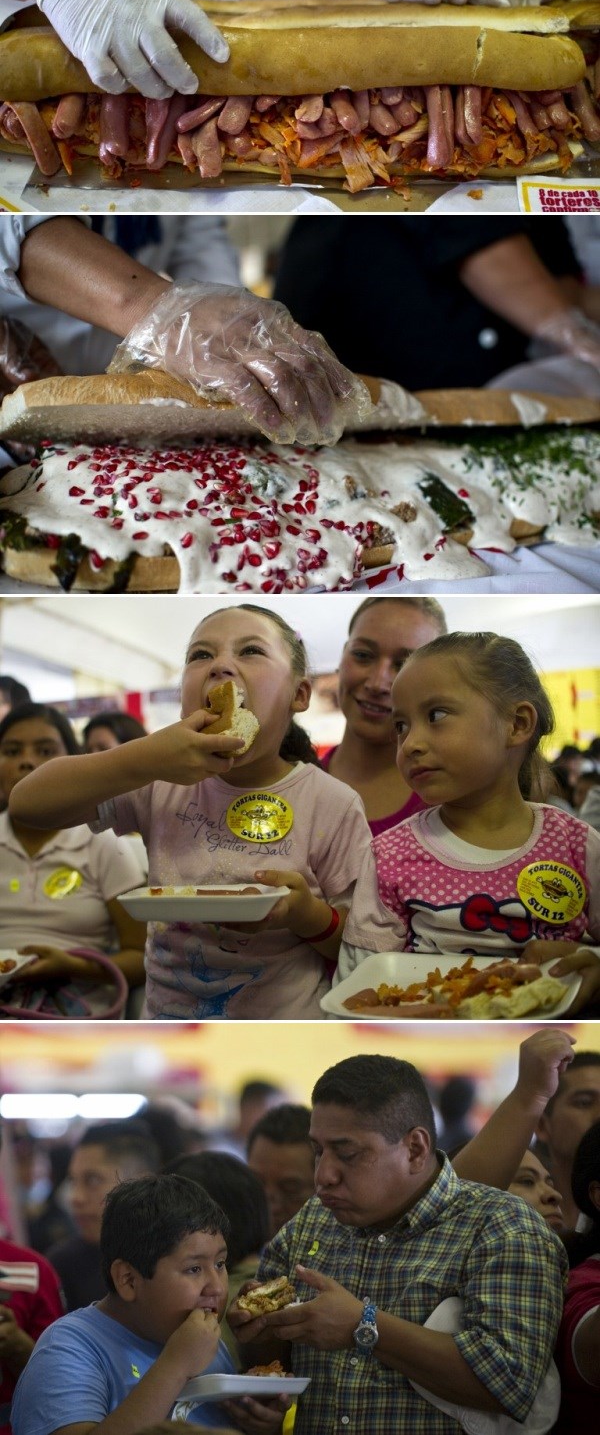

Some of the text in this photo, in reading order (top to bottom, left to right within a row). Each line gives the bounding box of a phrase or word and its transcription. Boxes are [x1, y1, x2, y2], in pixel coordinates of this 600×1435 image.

[539, 189, 545, 197] 8
[547, 189, 559, 197] de
[232, 794, 256, 812] TORTAS
[206, 831, 247, 852] Glitter
[241, 829, 264, 840] SUR
[528, 864, 558, 875] TORTAS
[558, 867, 583, 899] GIGANTES
[527, 897, 550, 918] SUR
[551, 911, 565, 920] 12
